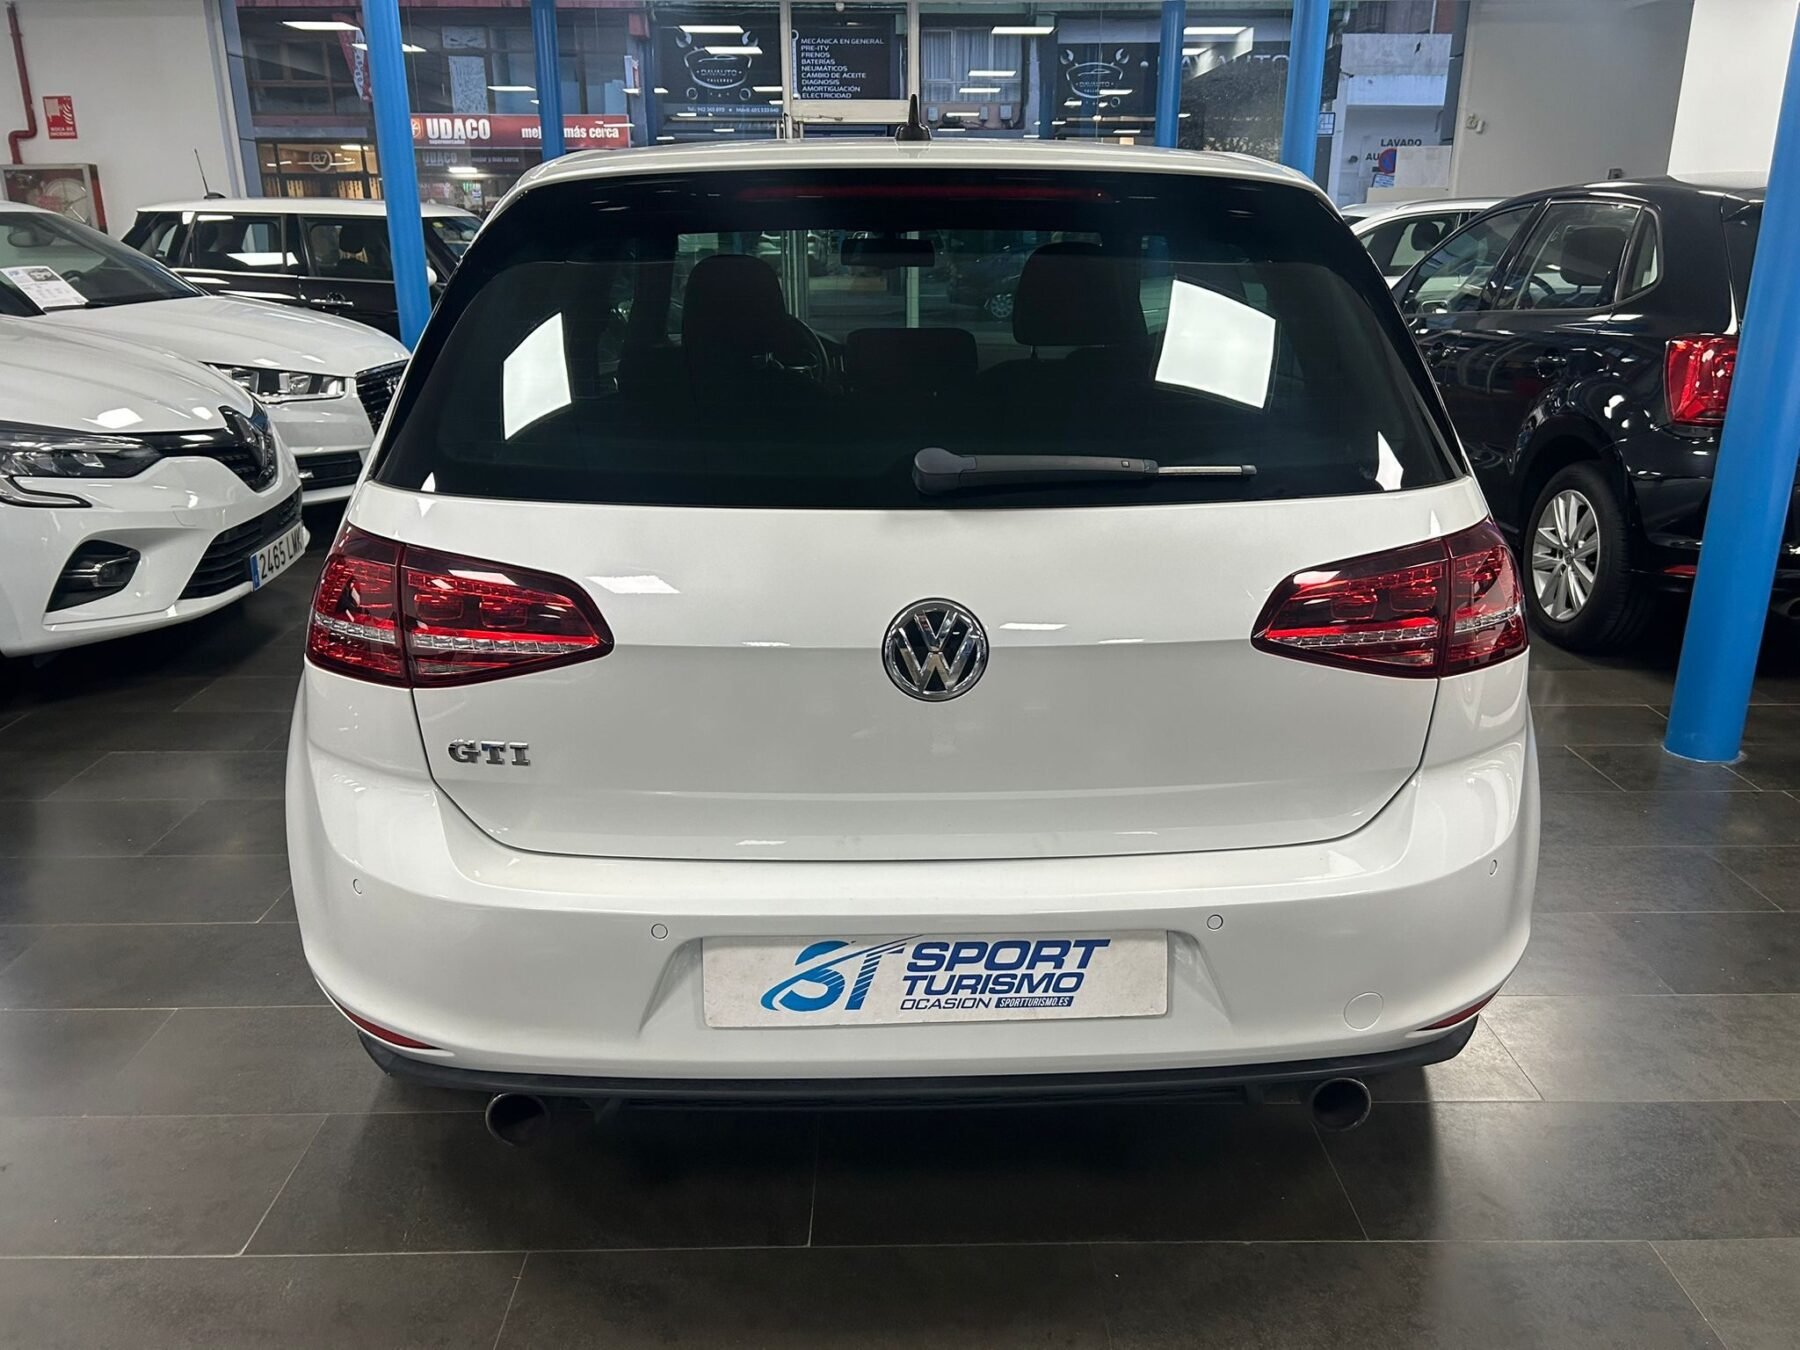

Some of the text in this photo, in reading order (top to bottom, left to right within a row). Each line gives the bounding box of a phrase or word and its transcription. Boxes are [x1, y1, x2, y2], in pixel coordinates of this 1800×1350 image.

[426, 118, 491, 140] UDACO
[522, 125, 619, 140] mej más cerca
[1380, 139, 1422, 147] LAVADO
[313, 154, 327, 164] 87
[260, 541, 286, 579] 2465
[448, 739, 530, 766] GTI
[907, 939, 1110, 972] SPORT
[903, 972, 1085, 996] TURISMO
[900, 996, 1068, 1010] OCASION SPORTTURISMO.ES
